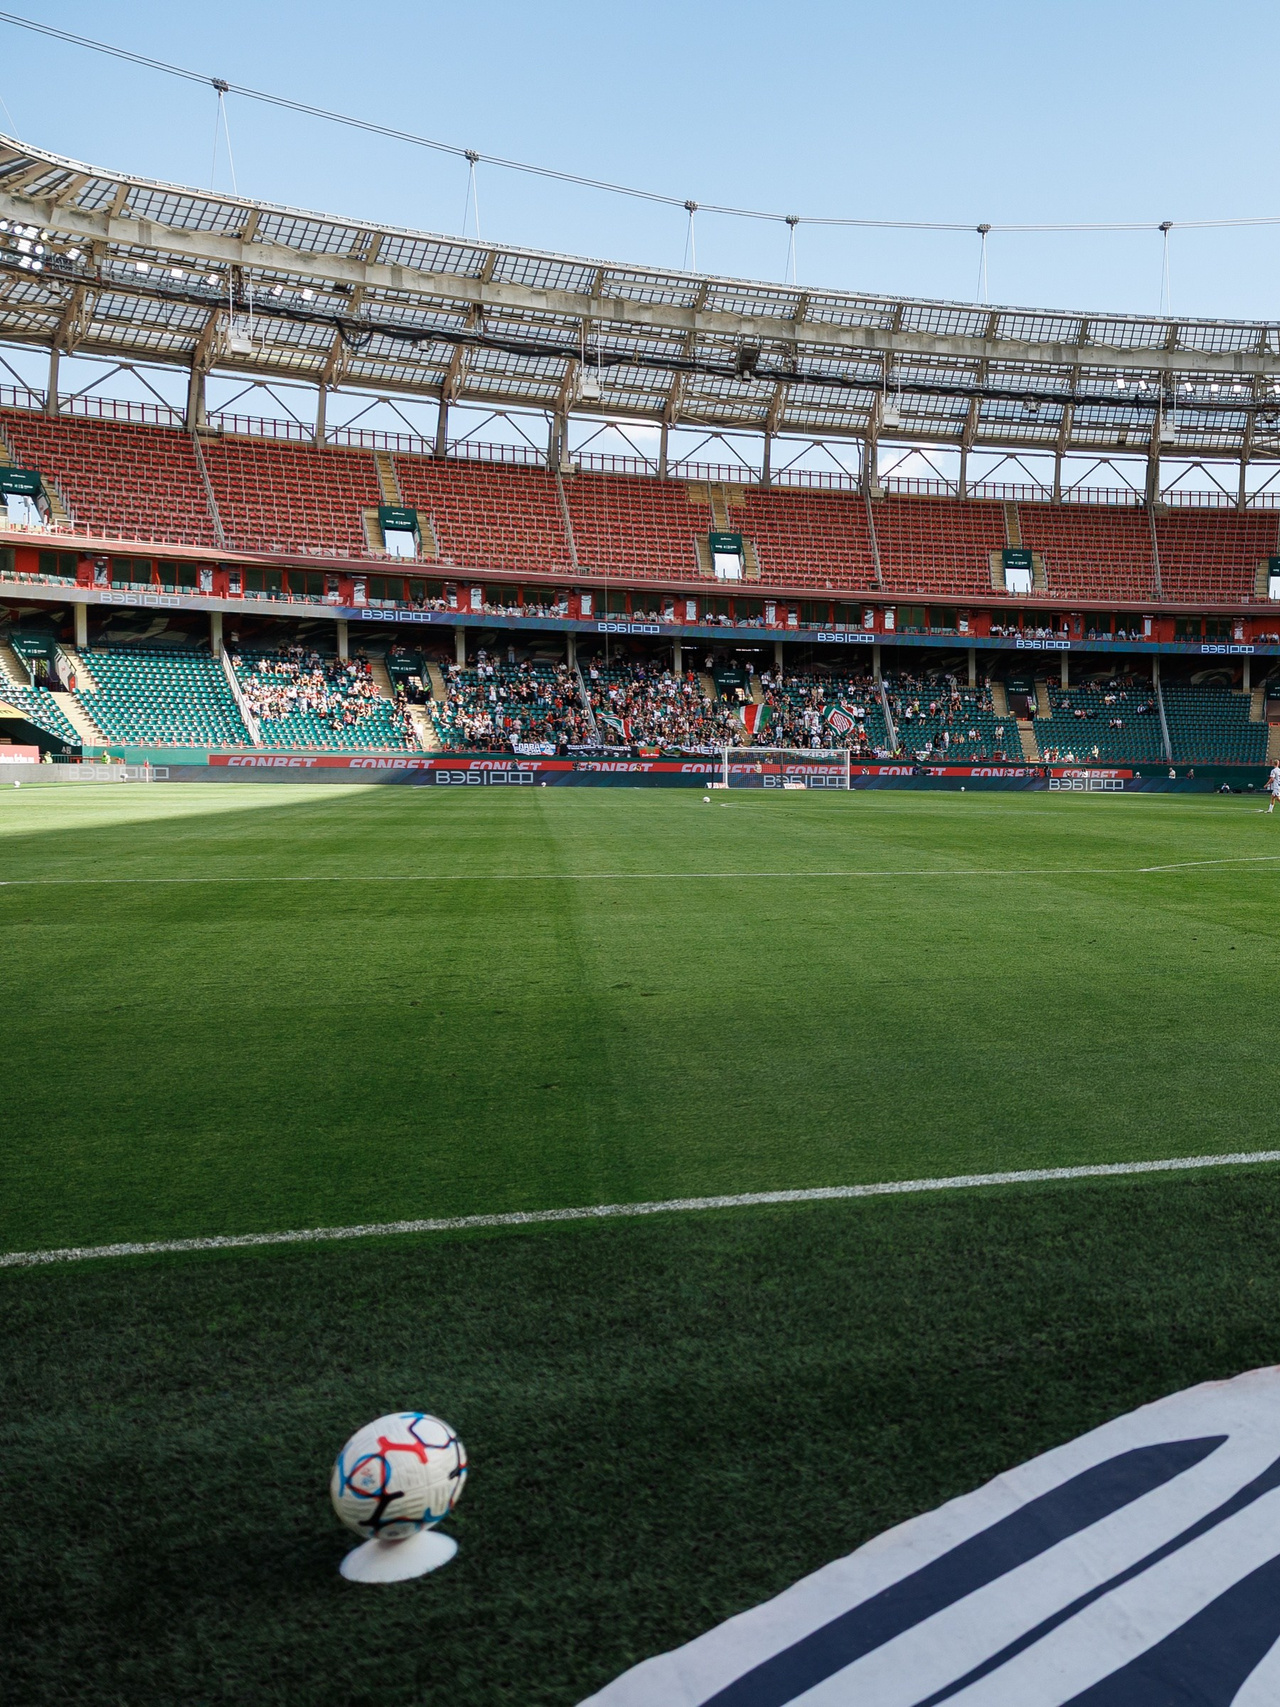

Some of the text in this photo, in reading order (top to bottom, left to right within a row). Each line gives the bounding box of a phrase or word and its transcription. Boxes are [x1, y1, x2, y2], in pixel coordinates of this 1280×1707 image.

[228, 756, 317, 767] FONBET
[349, 759, 434, 769] FONBET
[1062, 769, 1119, 778] FOBET
